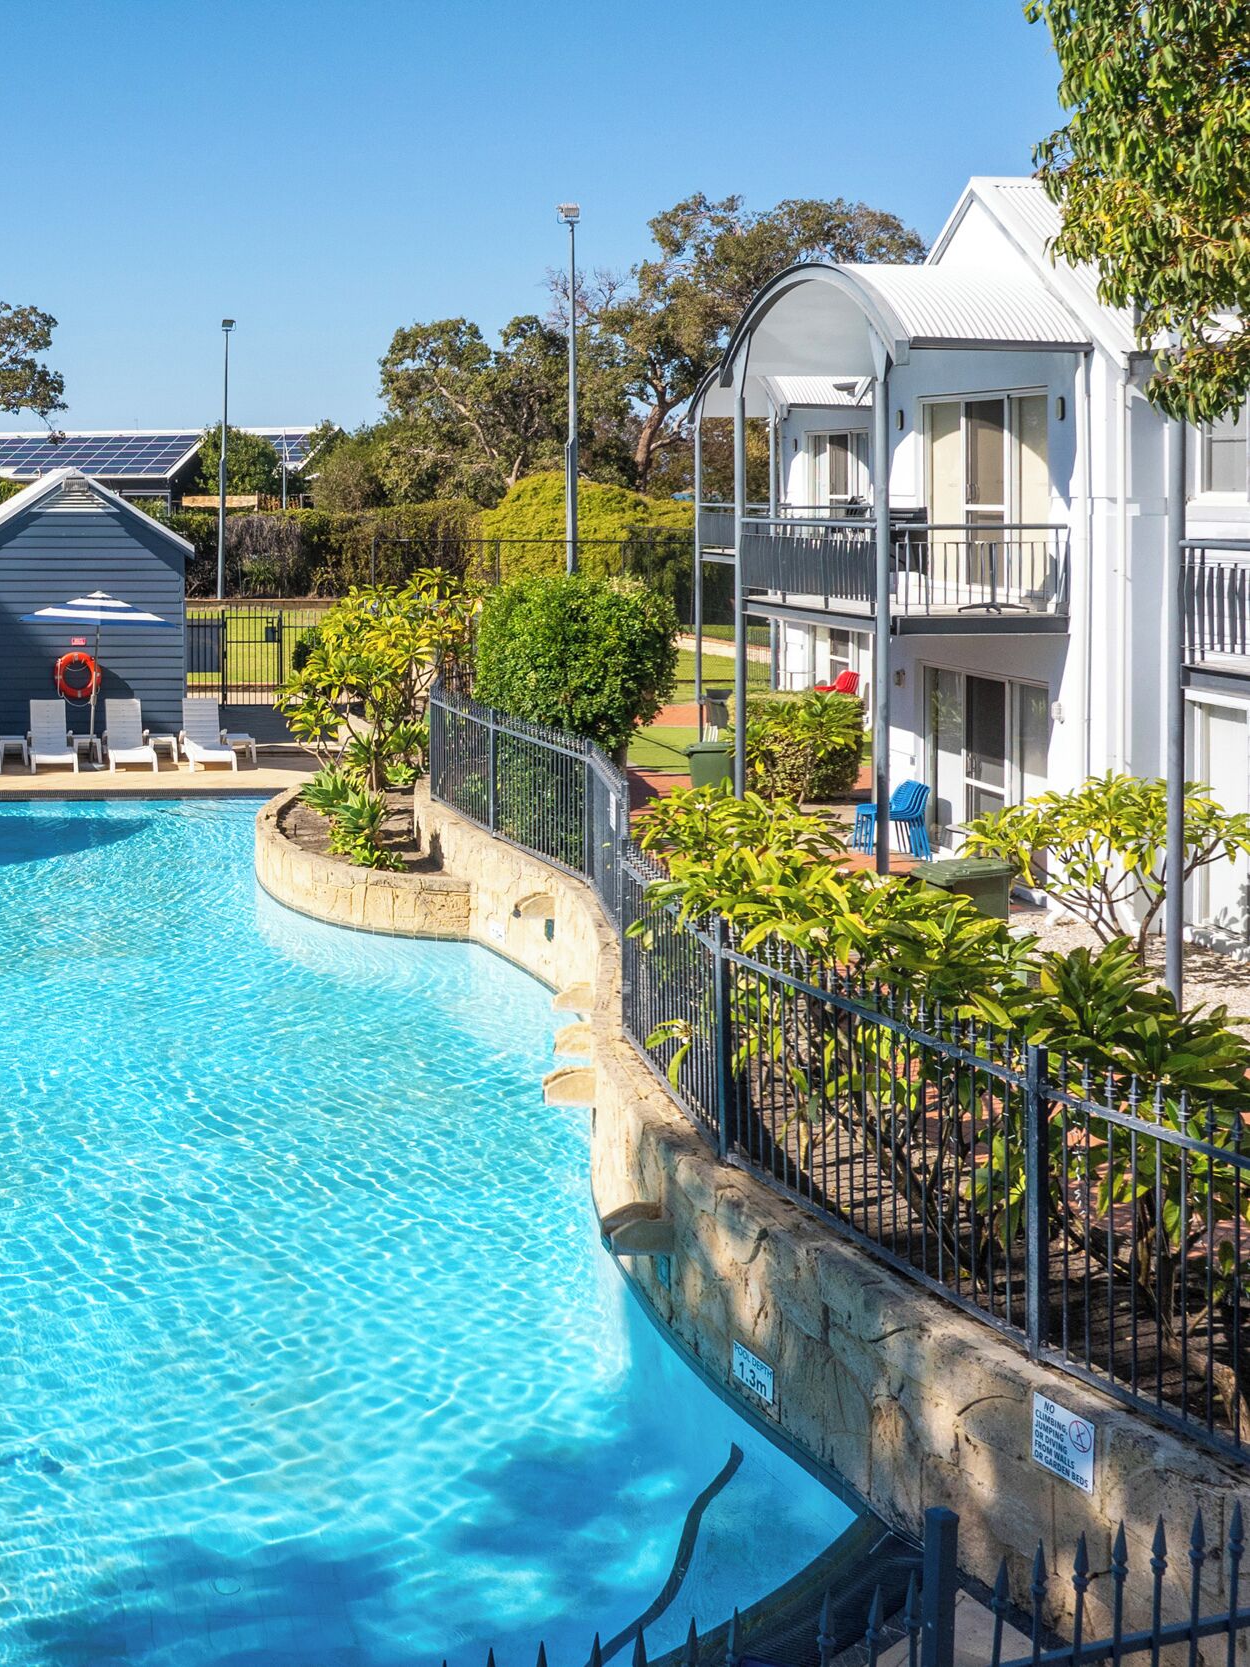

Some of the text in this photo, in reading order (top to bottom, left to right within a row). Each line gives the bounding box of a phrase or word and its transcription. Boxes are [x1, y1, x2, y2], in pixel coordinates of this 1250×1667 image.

[734, 1343, 772, 1379] POOL DEPTH
[739, 1361, 767, 1397] 1.3m
[1044, 1401, 1055, 1414] NO
[1035, 1409, 1068, 1436] CLIMBING,
[1035, 1419, 1064, 1442] JUMPING
[1034, 1440, 1075, 1470] FROM WALLS
[1035, 1429, 1068, 1455] OR DIVING
[1034, 1449, 1089, 1488] OR GARDEN BEDS
